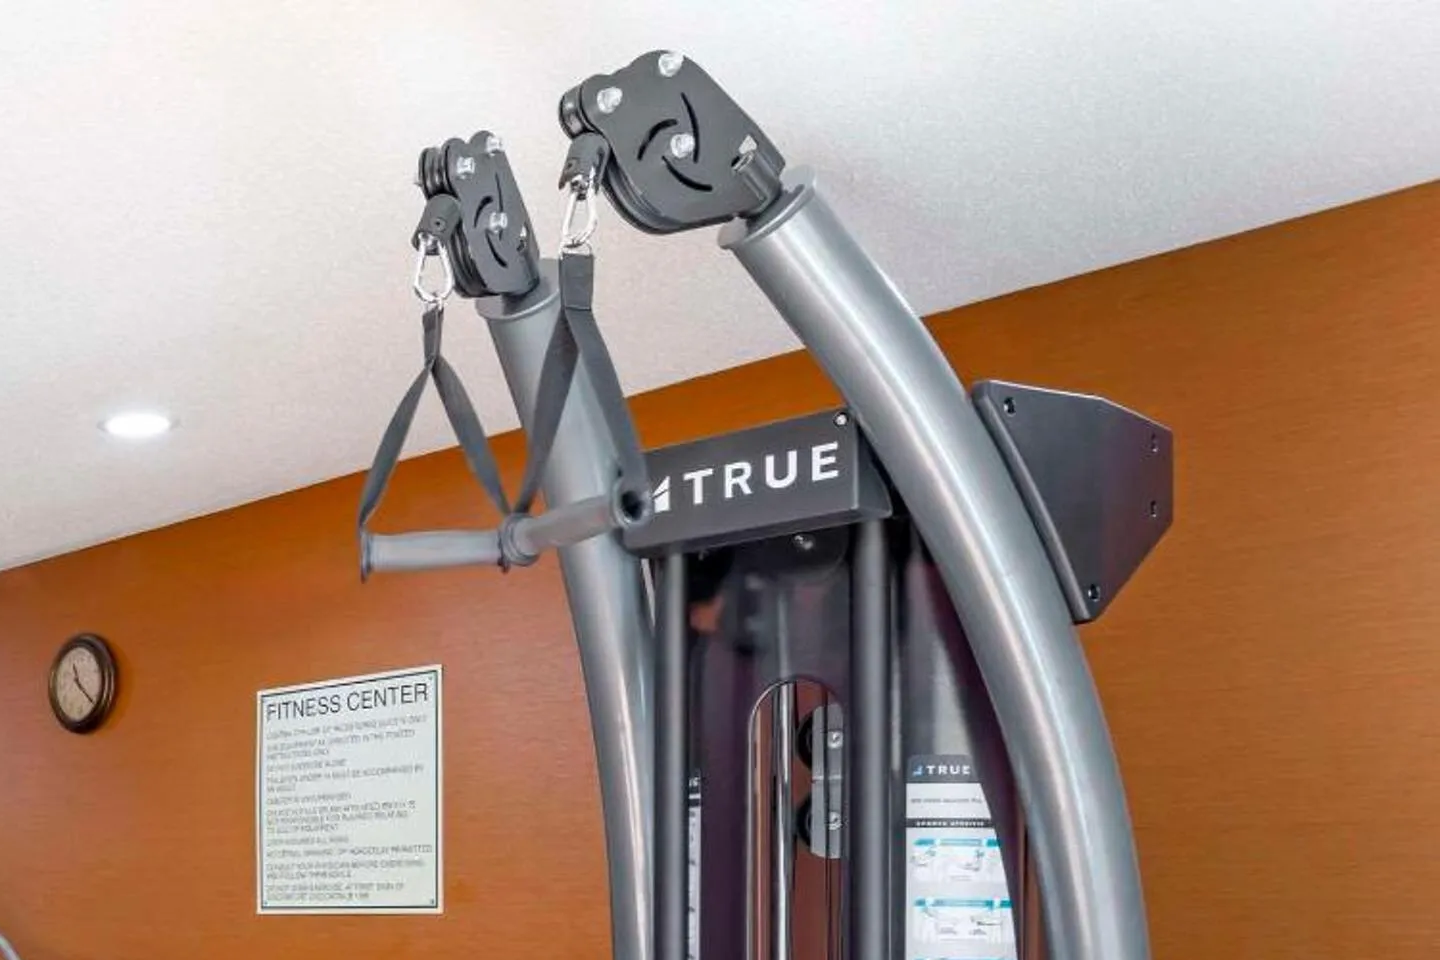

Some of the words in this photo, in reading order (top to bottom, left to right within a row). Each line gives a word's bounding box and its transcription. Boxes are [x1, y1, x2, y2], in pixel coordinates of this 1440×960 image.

[682, 441, 840, 506] TRUE
[266, 693, 342, 723] FITNESS
[346, 682, 429, 712] CENTER
[926, 765, 971, 776] TRUE
